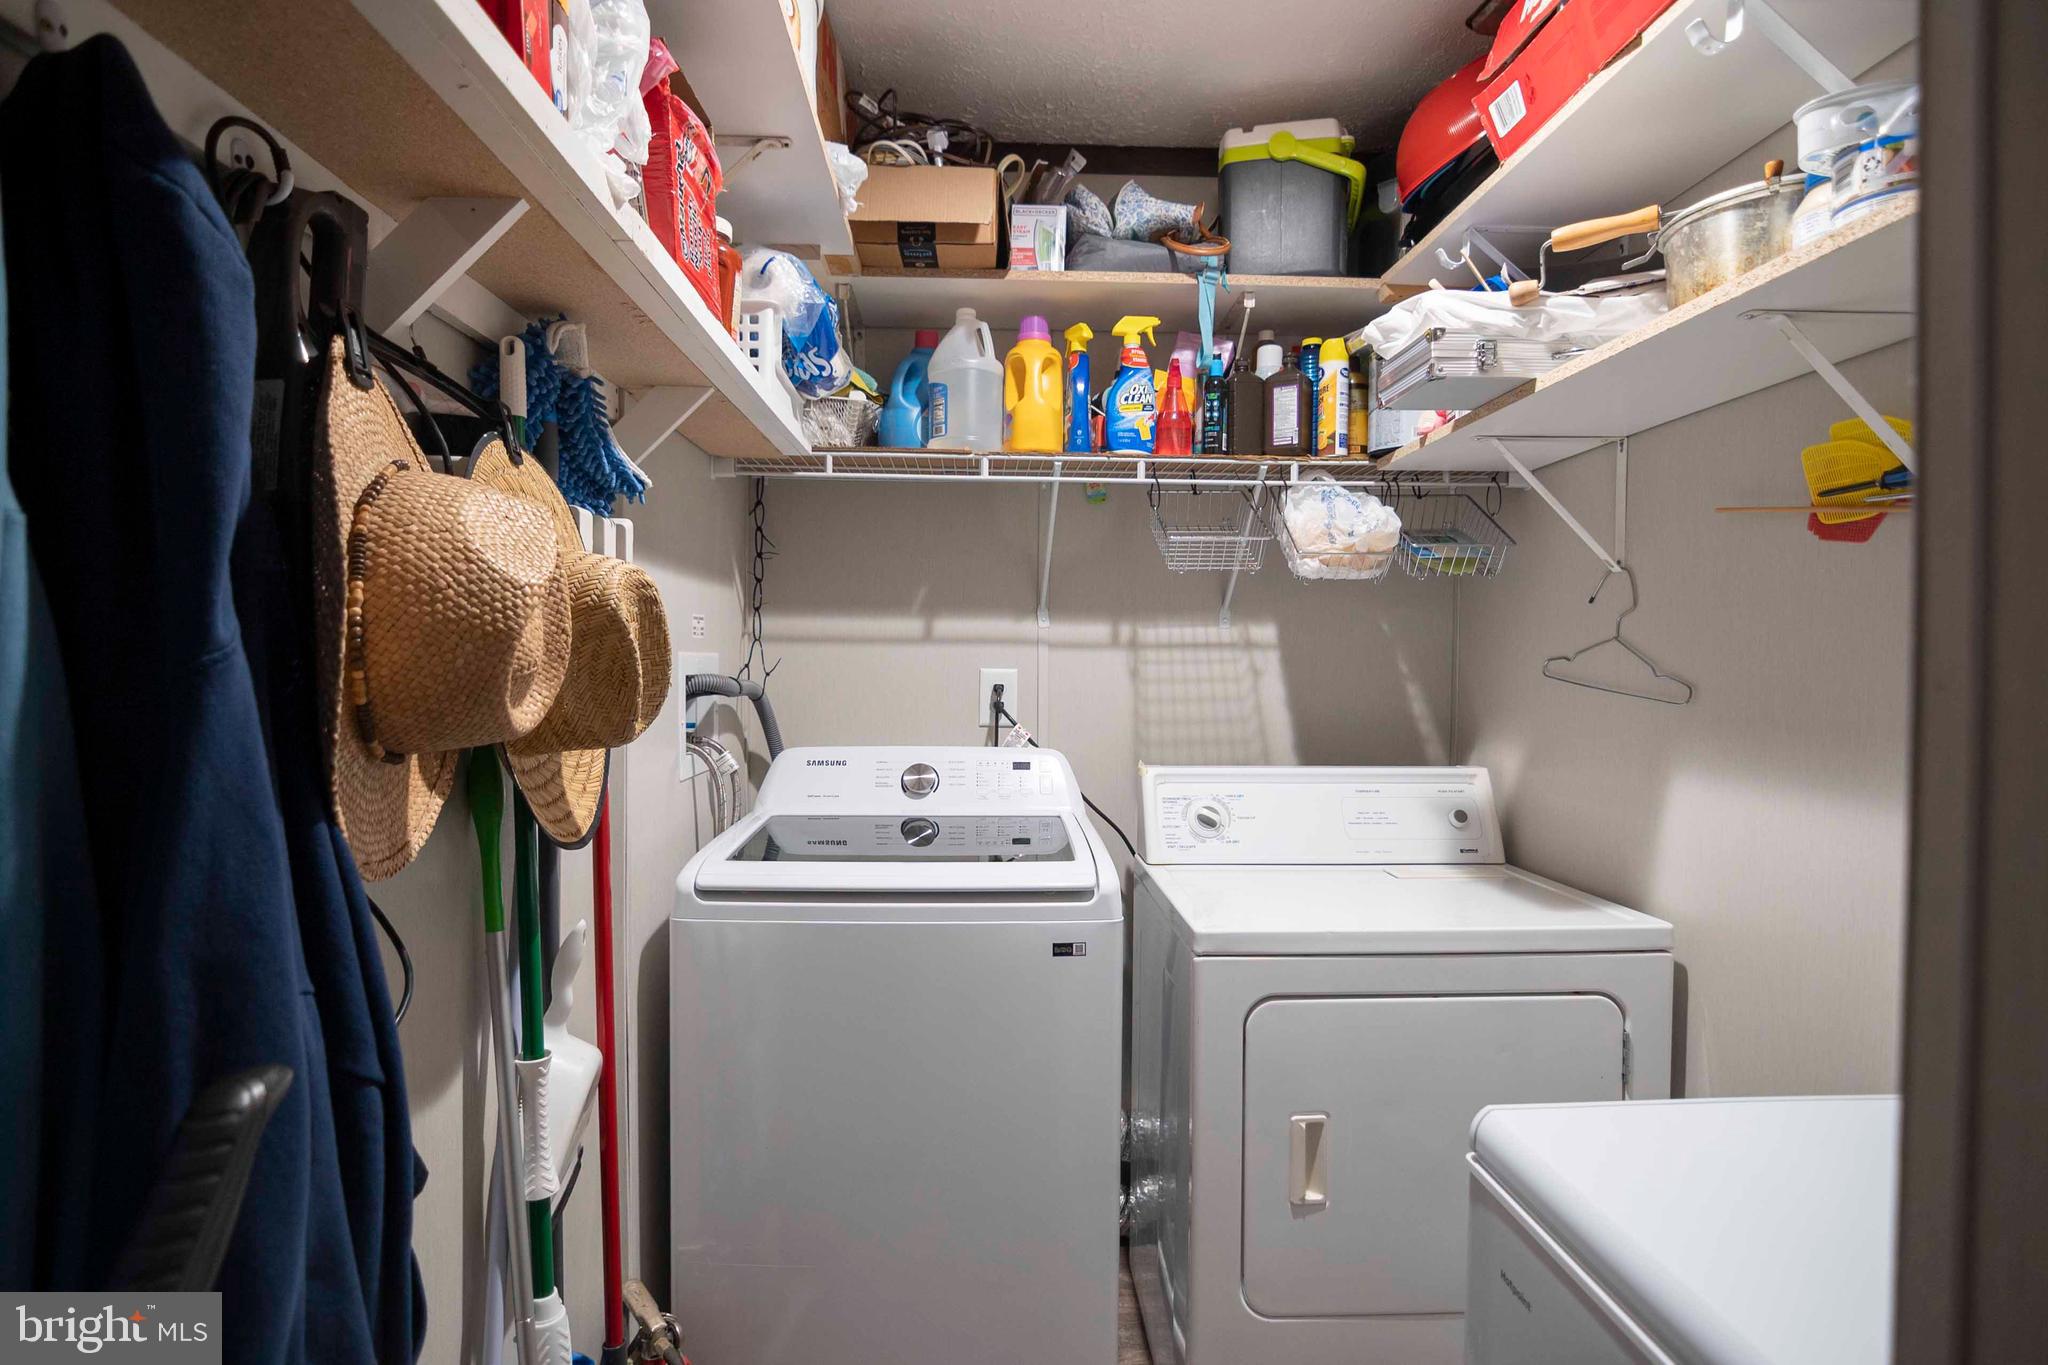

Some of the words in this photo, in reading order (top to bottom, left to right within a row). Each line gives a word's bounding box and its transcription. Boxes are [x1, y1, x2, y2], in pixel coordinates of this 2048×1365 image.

[1130, 384, 1148, 394] OXI
[1120, 393, 1153, 404] CLEAN
[806, 759, 848, 767] SAMSUNG
